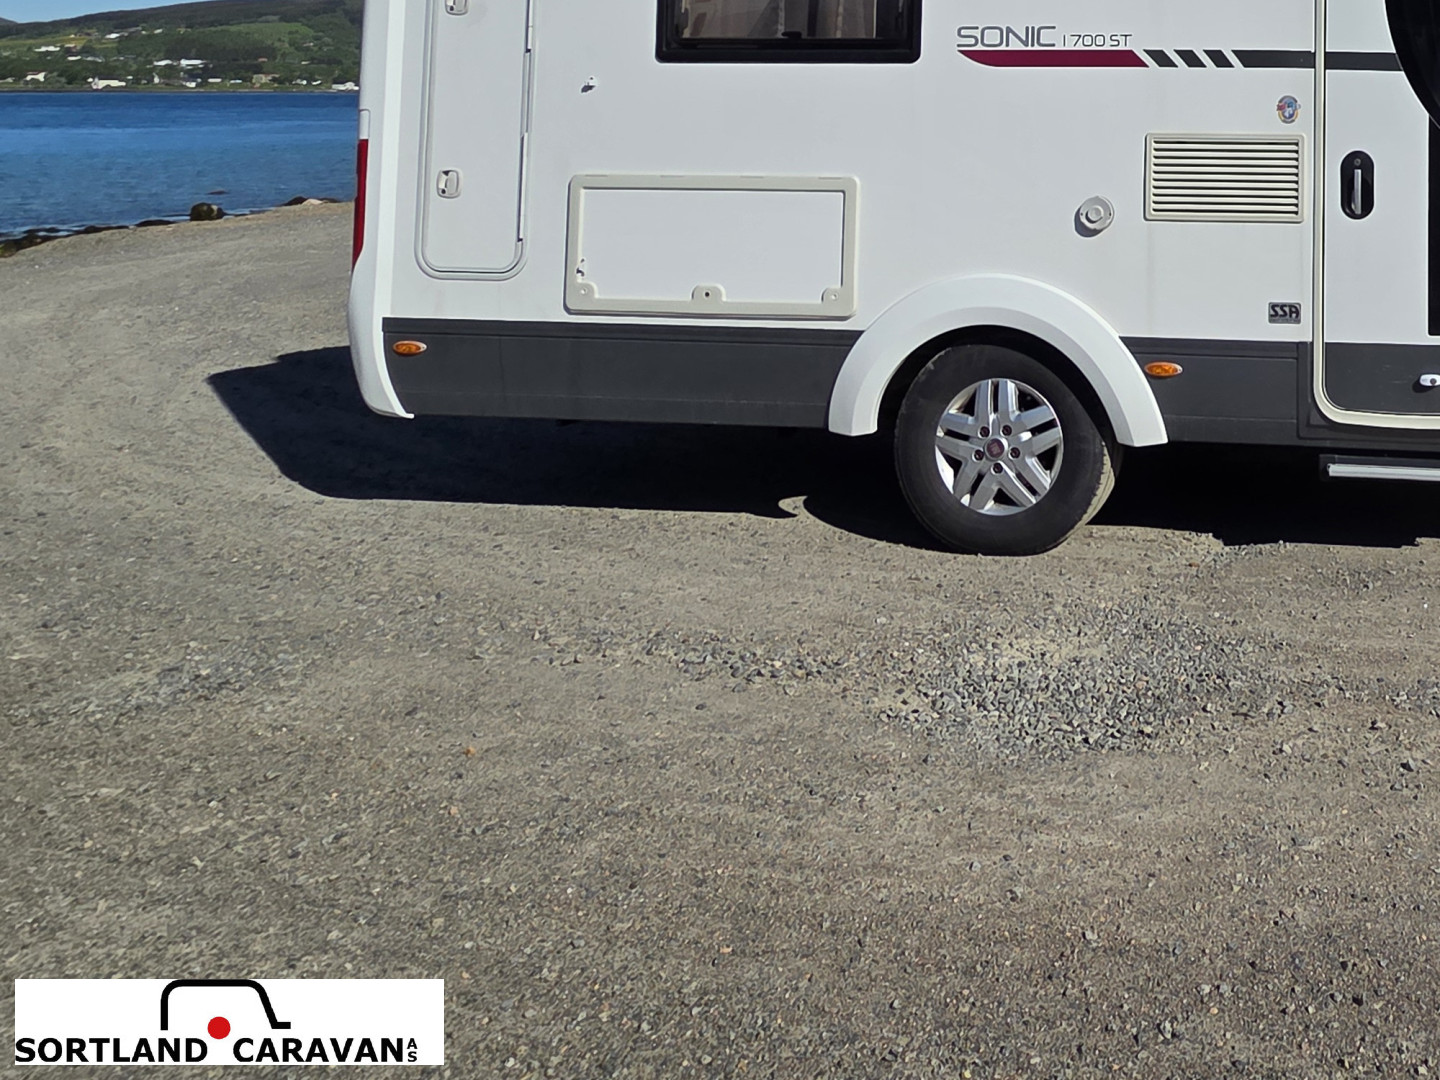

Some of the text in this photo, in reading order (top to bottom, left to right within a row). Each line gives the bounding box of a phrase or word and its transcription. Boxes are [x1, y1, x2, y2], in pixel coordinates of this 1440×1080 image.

[957, 26, 1056, 47] SONIC
[1070, 34, 1105, 47] 700
[1109, 34, 1132, 47] ST
